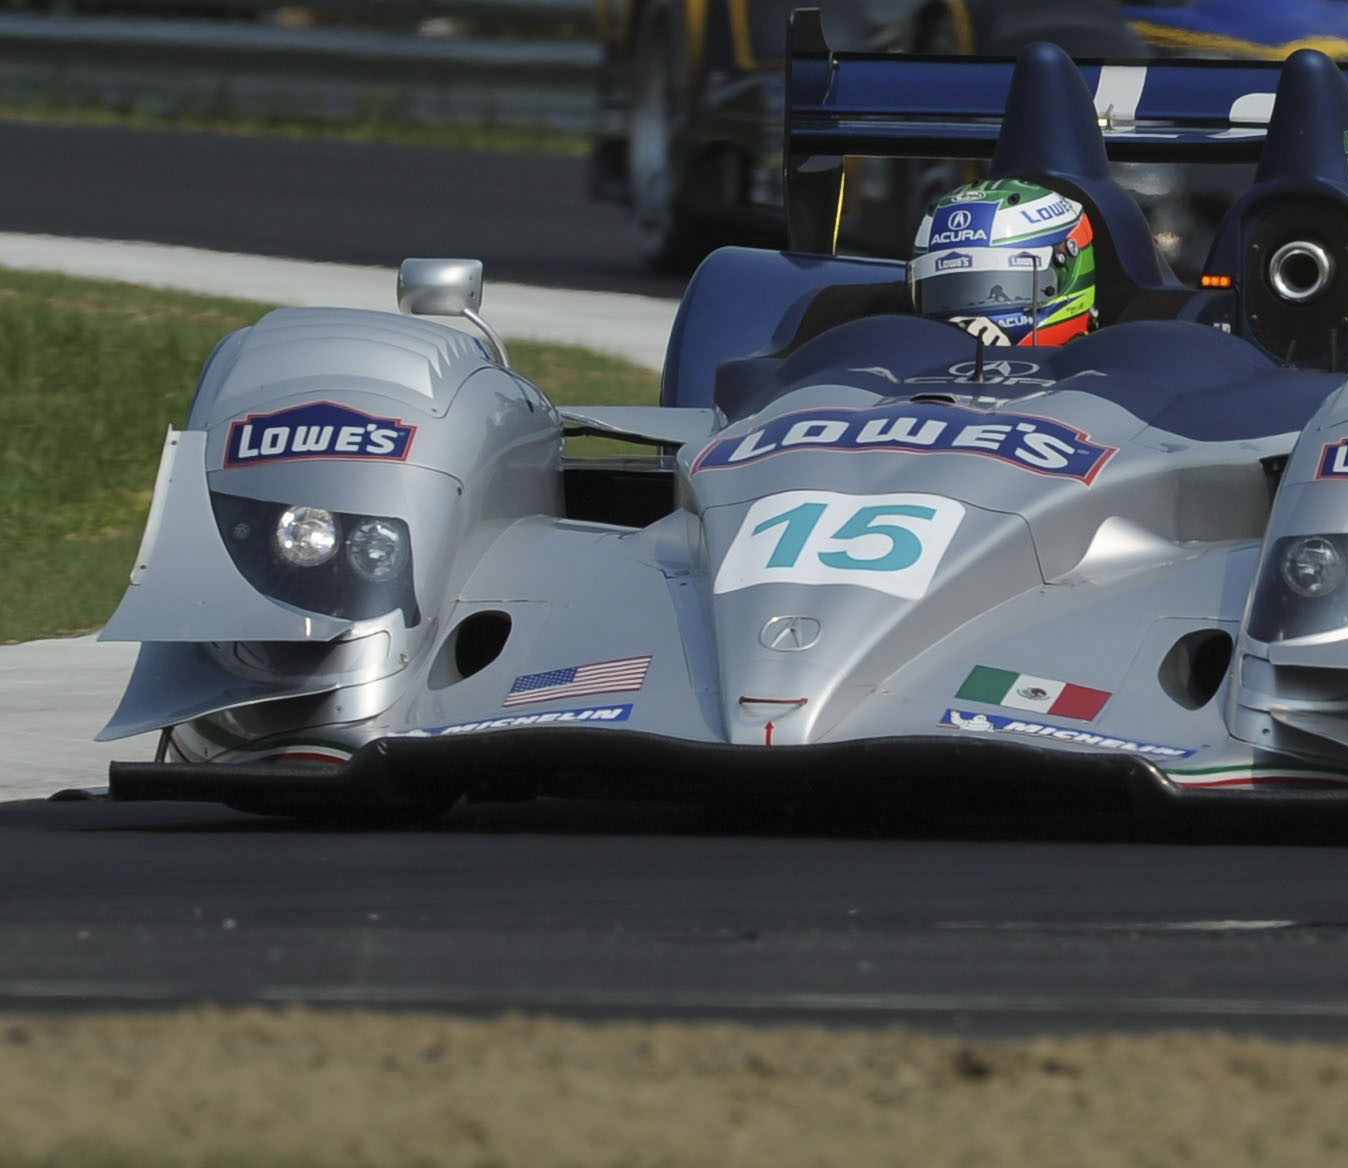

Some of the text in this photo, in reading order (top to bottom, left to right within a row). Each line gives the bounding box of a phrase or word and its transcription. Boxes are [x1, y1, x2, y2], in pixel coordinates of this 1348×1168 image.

[931, 229, 987, 246] ACURA
[237, 423, 399, 459] LOWE'S
[728, 417, 1076, 469] LOWE'S
[750, 502, 938, 572] 15
[439, 707, 624, 733] MICHELIN
[1002, 721, 1187, 756] MICHELIN
